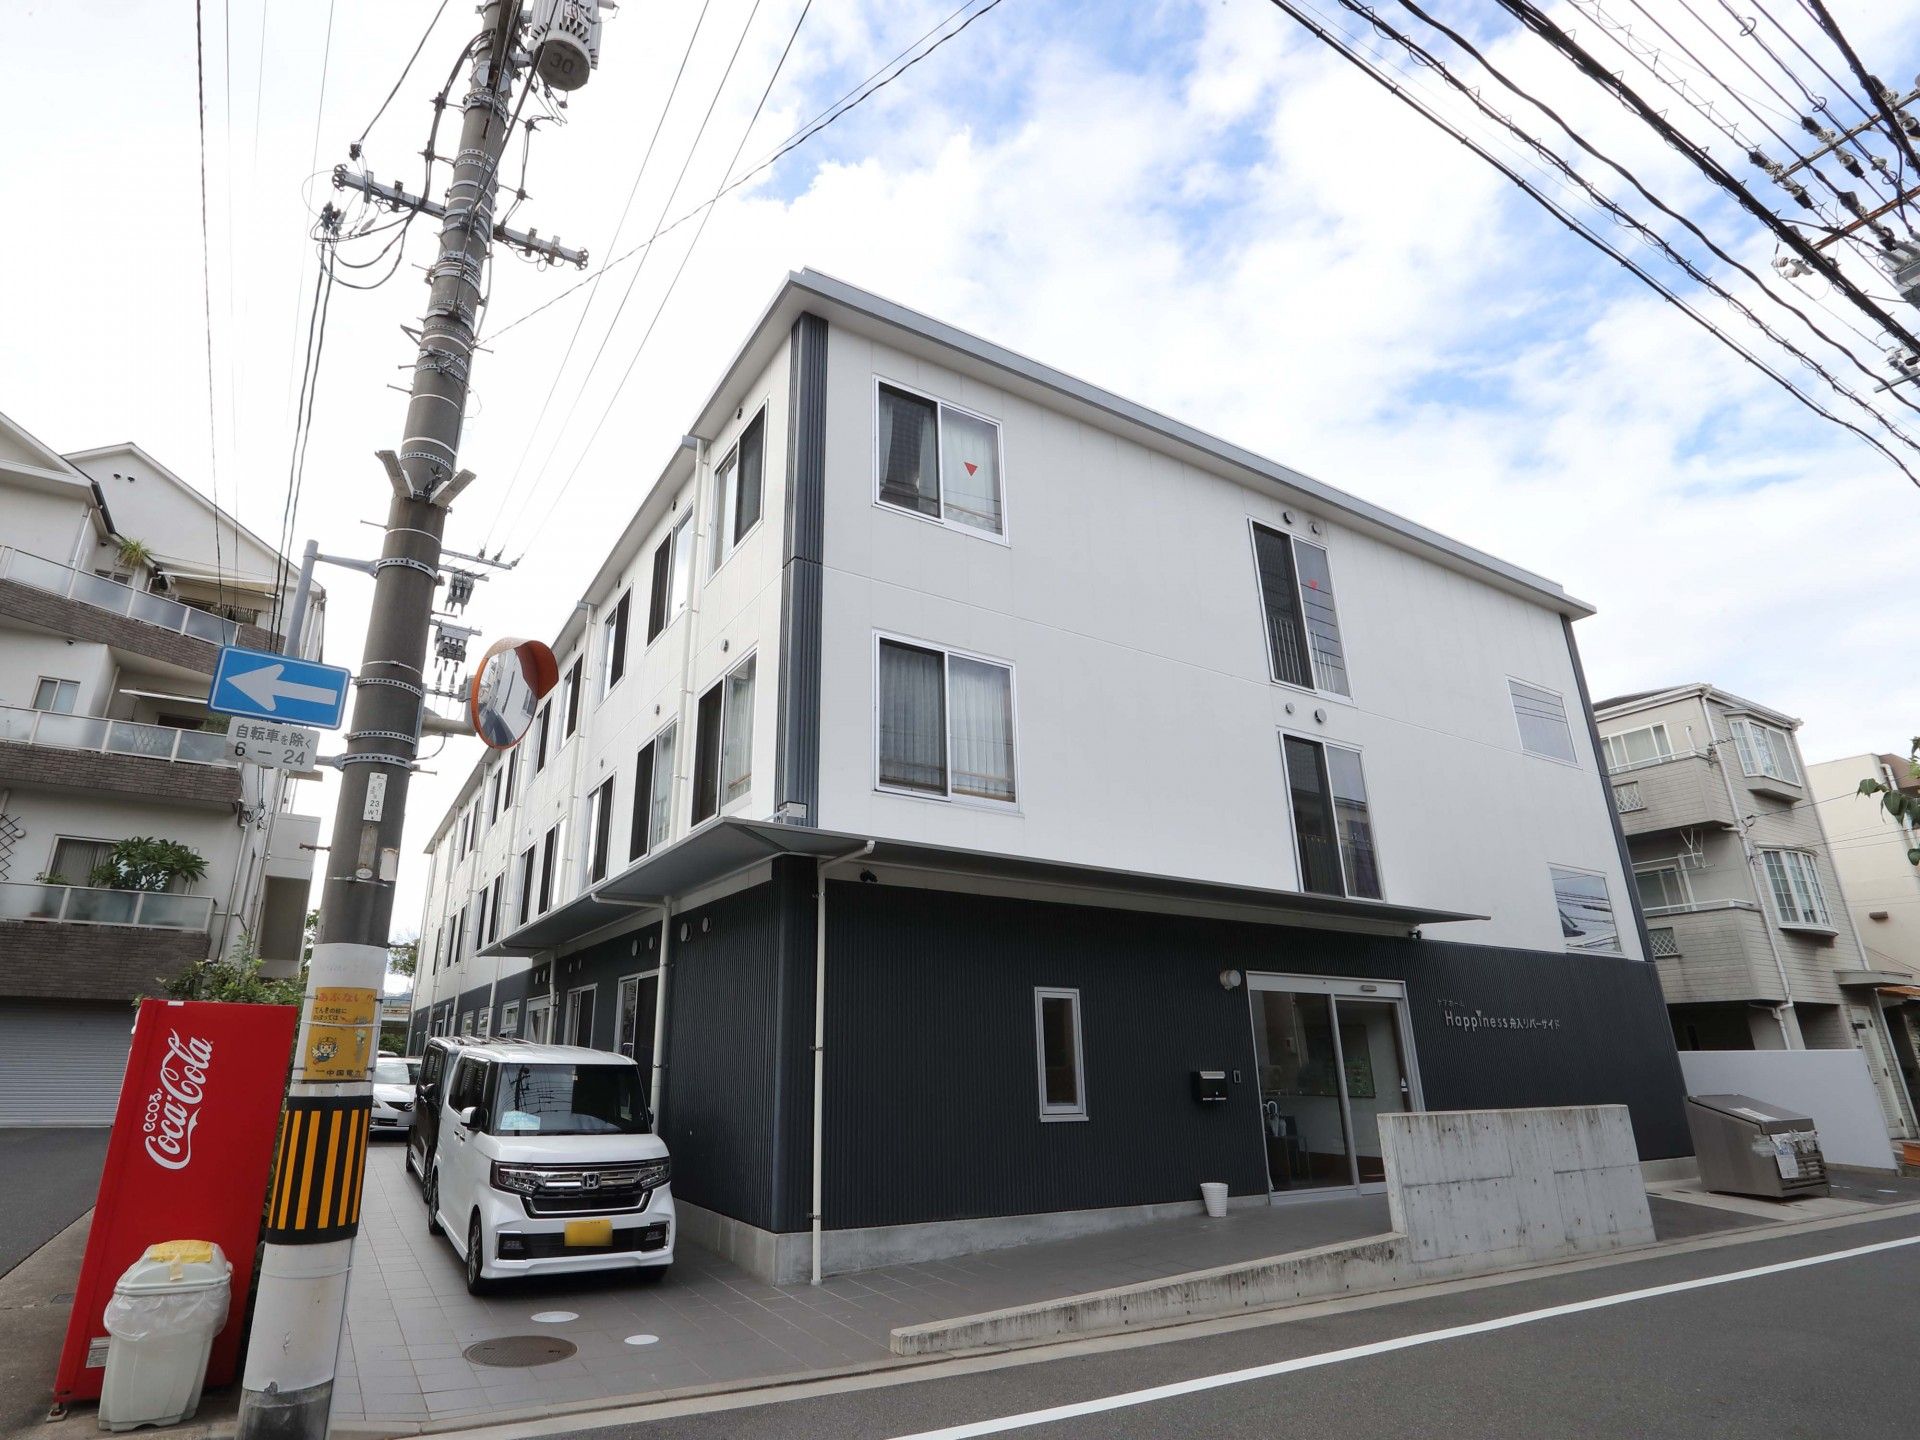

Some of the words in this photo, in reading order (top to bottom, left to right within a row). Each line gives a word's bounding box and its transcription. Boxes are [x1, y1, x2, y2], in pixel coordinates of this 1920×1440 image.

[551, 52, 574, 74] 30
[235, 724, 312, 749] 自転車を除く
[234, 741, 246, 757] 6
[282, 750, 305, 765] 24
[1445, 1010, 1508, 1032] Happiness
[145, 1028, 213, 1170] Coca-Cola
